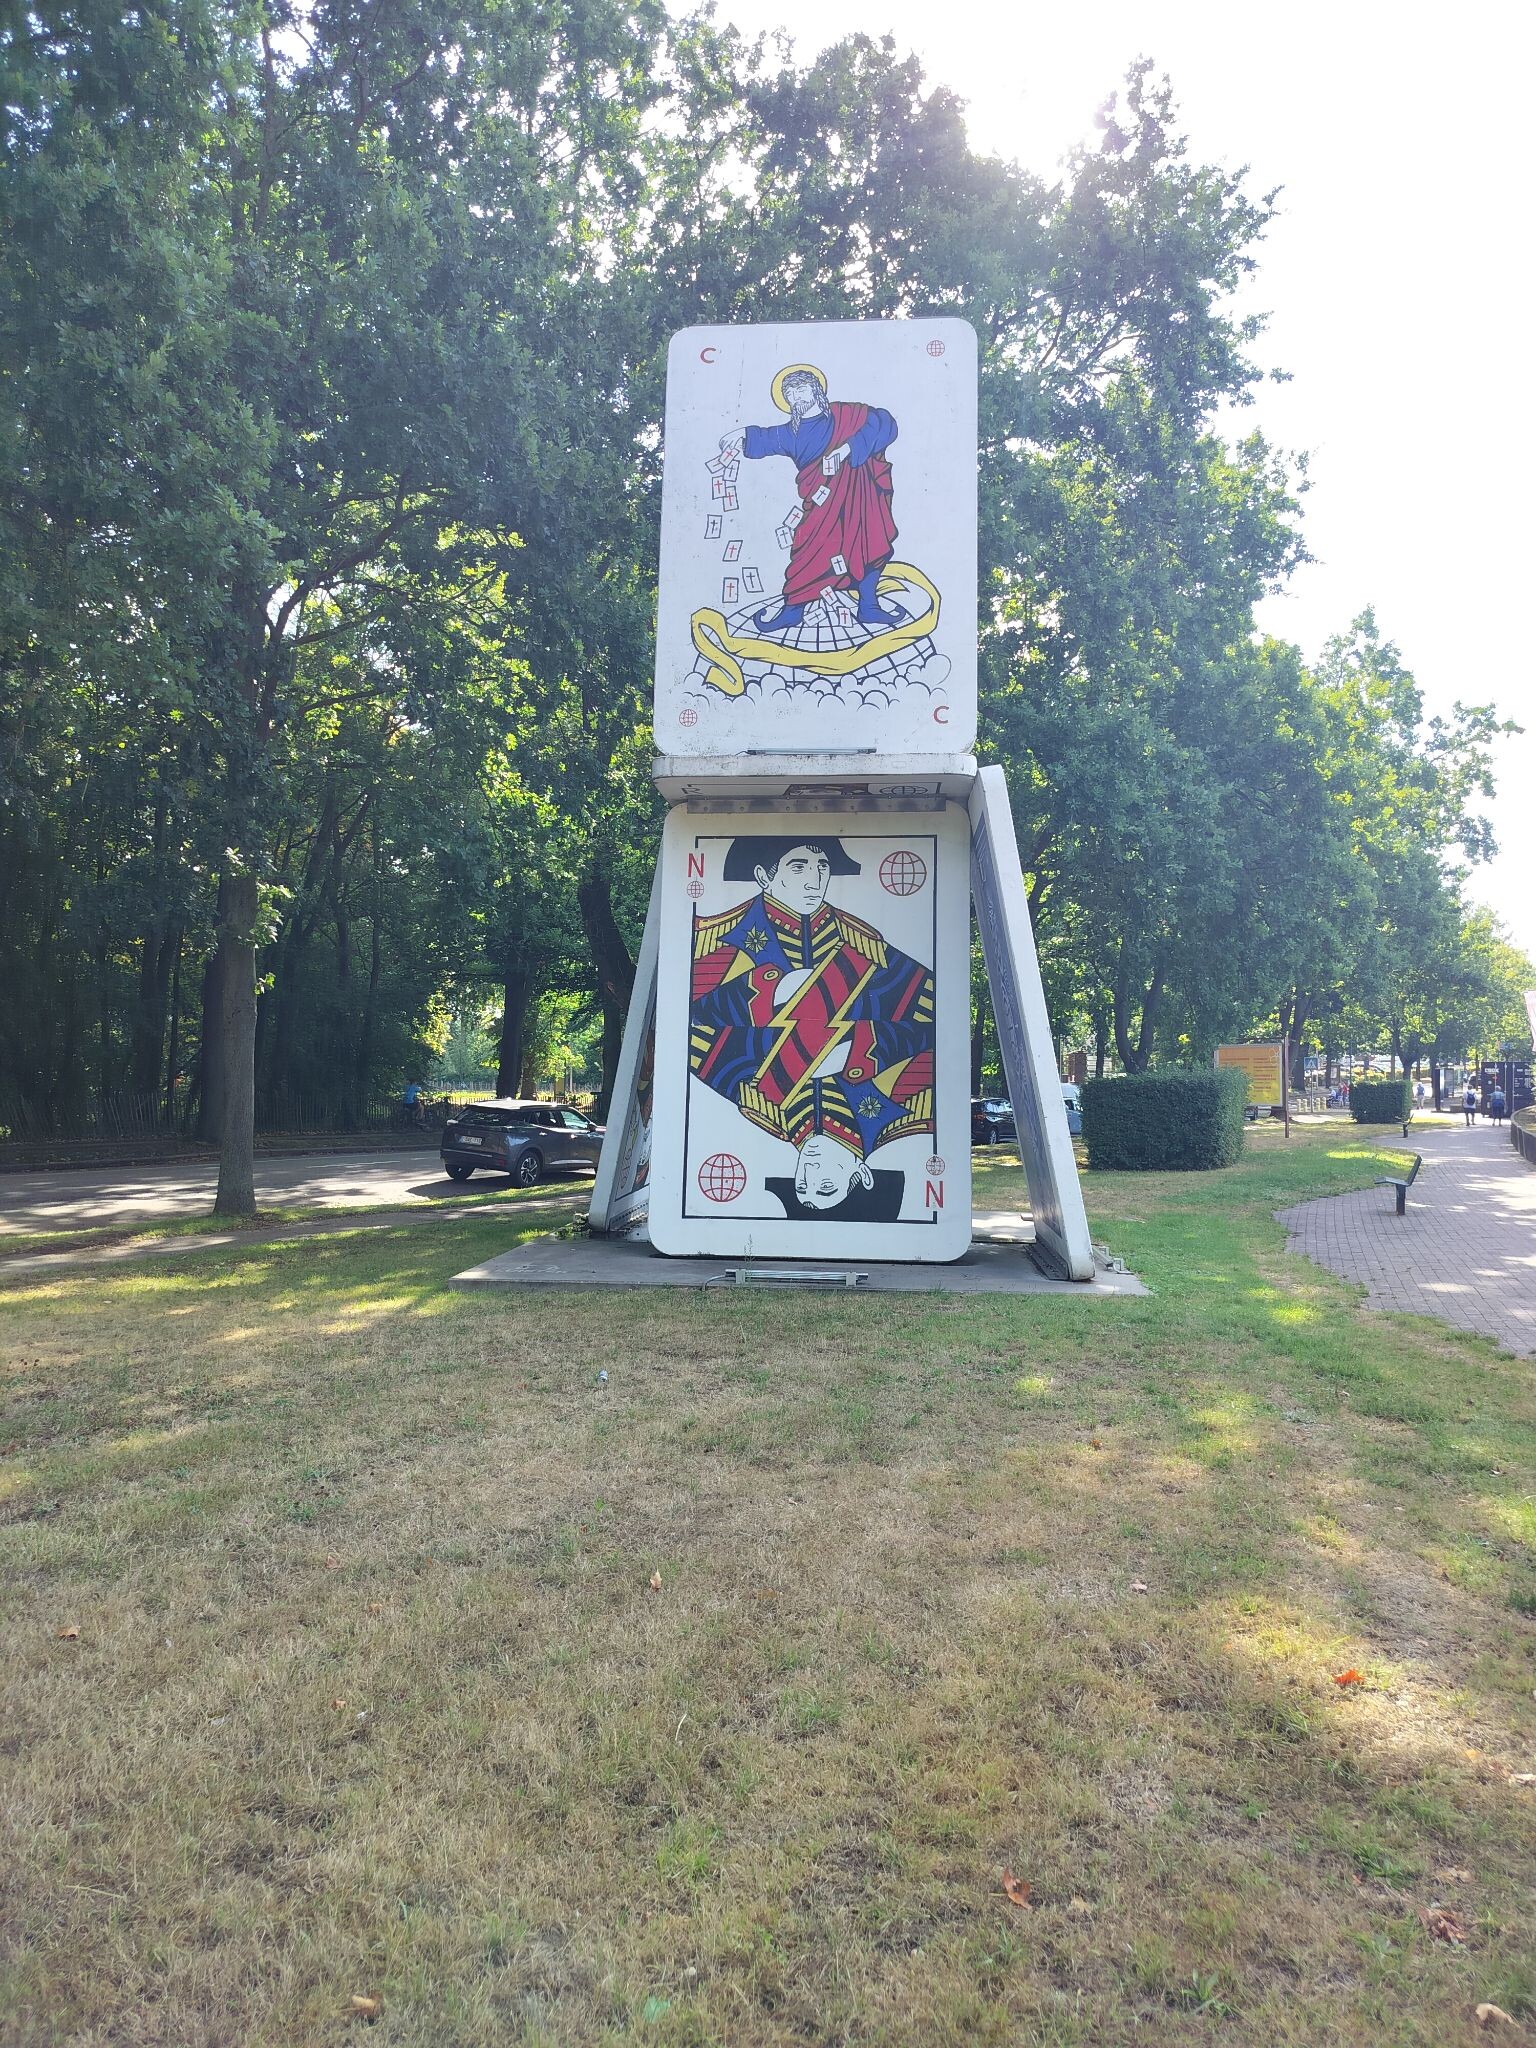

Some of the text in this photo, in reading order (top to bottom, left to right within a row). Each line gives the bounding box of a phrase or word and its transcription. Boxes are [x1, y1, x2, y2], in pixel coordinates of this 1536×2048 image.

[700, 347, 716, 364] C
[934, 705, 949, 724] C
[688, 852, 704, 878] N
[926, 1180, 944, 1208] N
